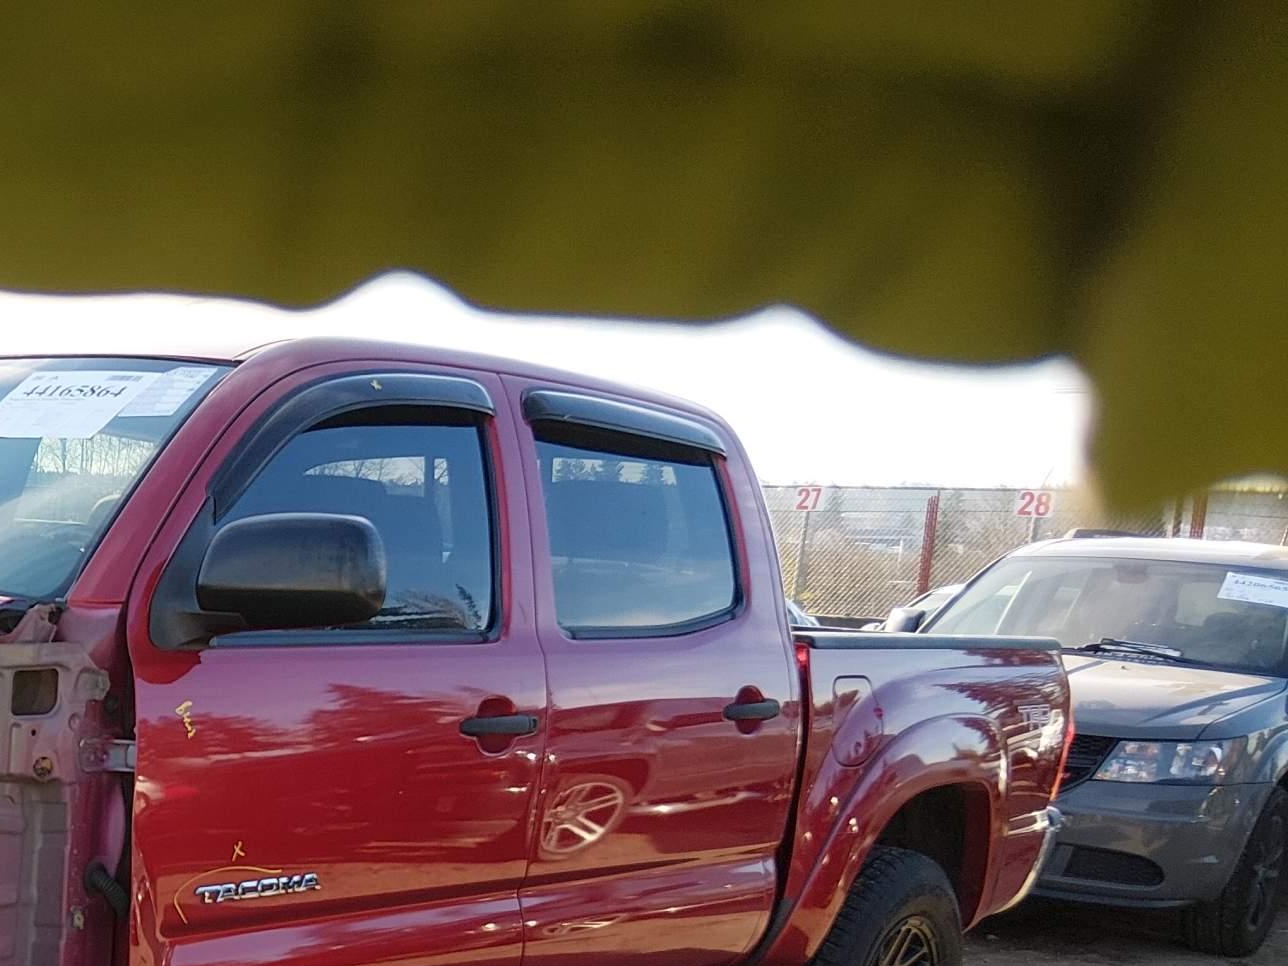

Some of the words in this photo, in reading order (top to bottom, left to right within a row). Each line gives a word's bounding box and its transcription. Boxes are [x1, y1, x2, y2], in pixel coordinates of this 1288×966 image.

[23, 384, 128, 399] 44165864
[795, 487, 823, 511] 27
[1016, 491, 1052, 517] 28
[195, 872, 322, 904] TACOMA
